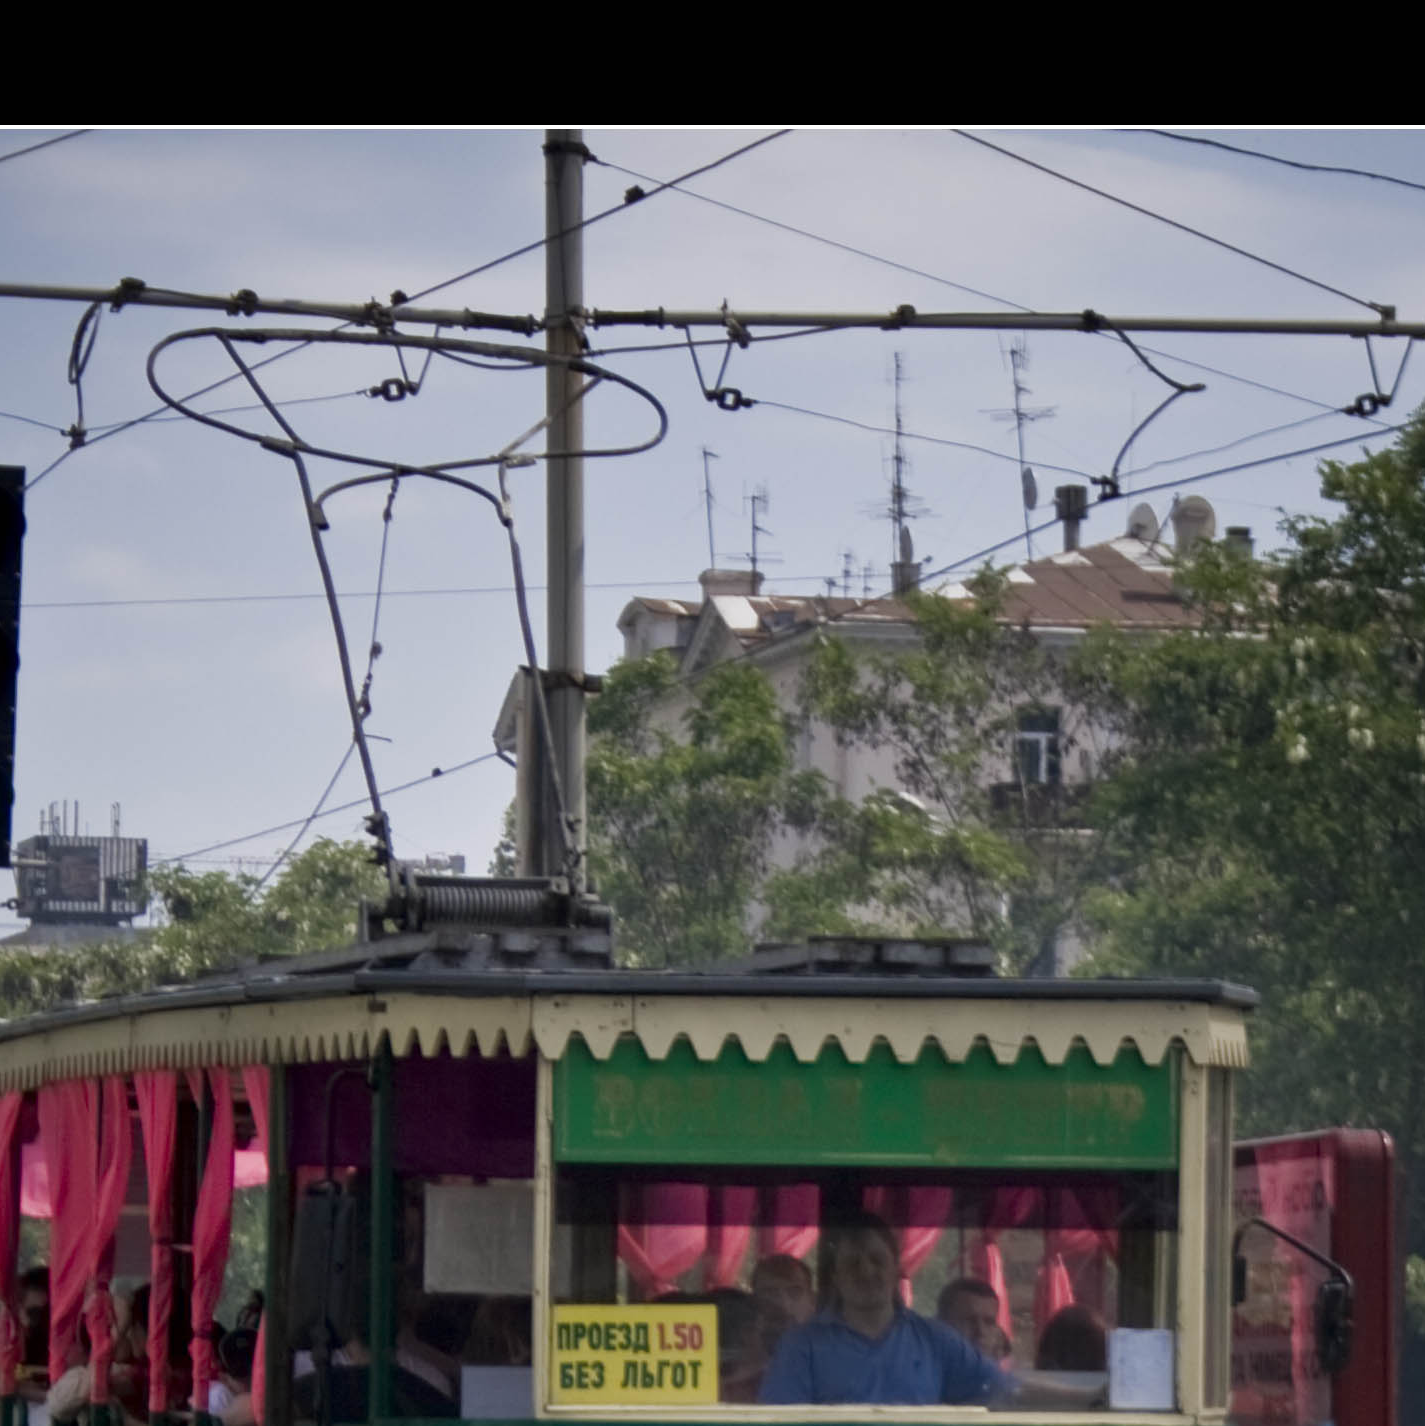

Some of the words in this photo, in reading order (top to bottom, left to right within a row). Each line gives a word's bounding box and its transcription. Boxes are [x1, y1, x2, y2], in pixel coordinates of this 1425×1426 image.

[557, 1322, 650, 1353] ПРОЕЗД
[657, 1323, 704, 1351] 1.50
[560, 1361, 605, 1389] БЕЗ
[621, 1360, 702, 1389] ЛЬГОТ
